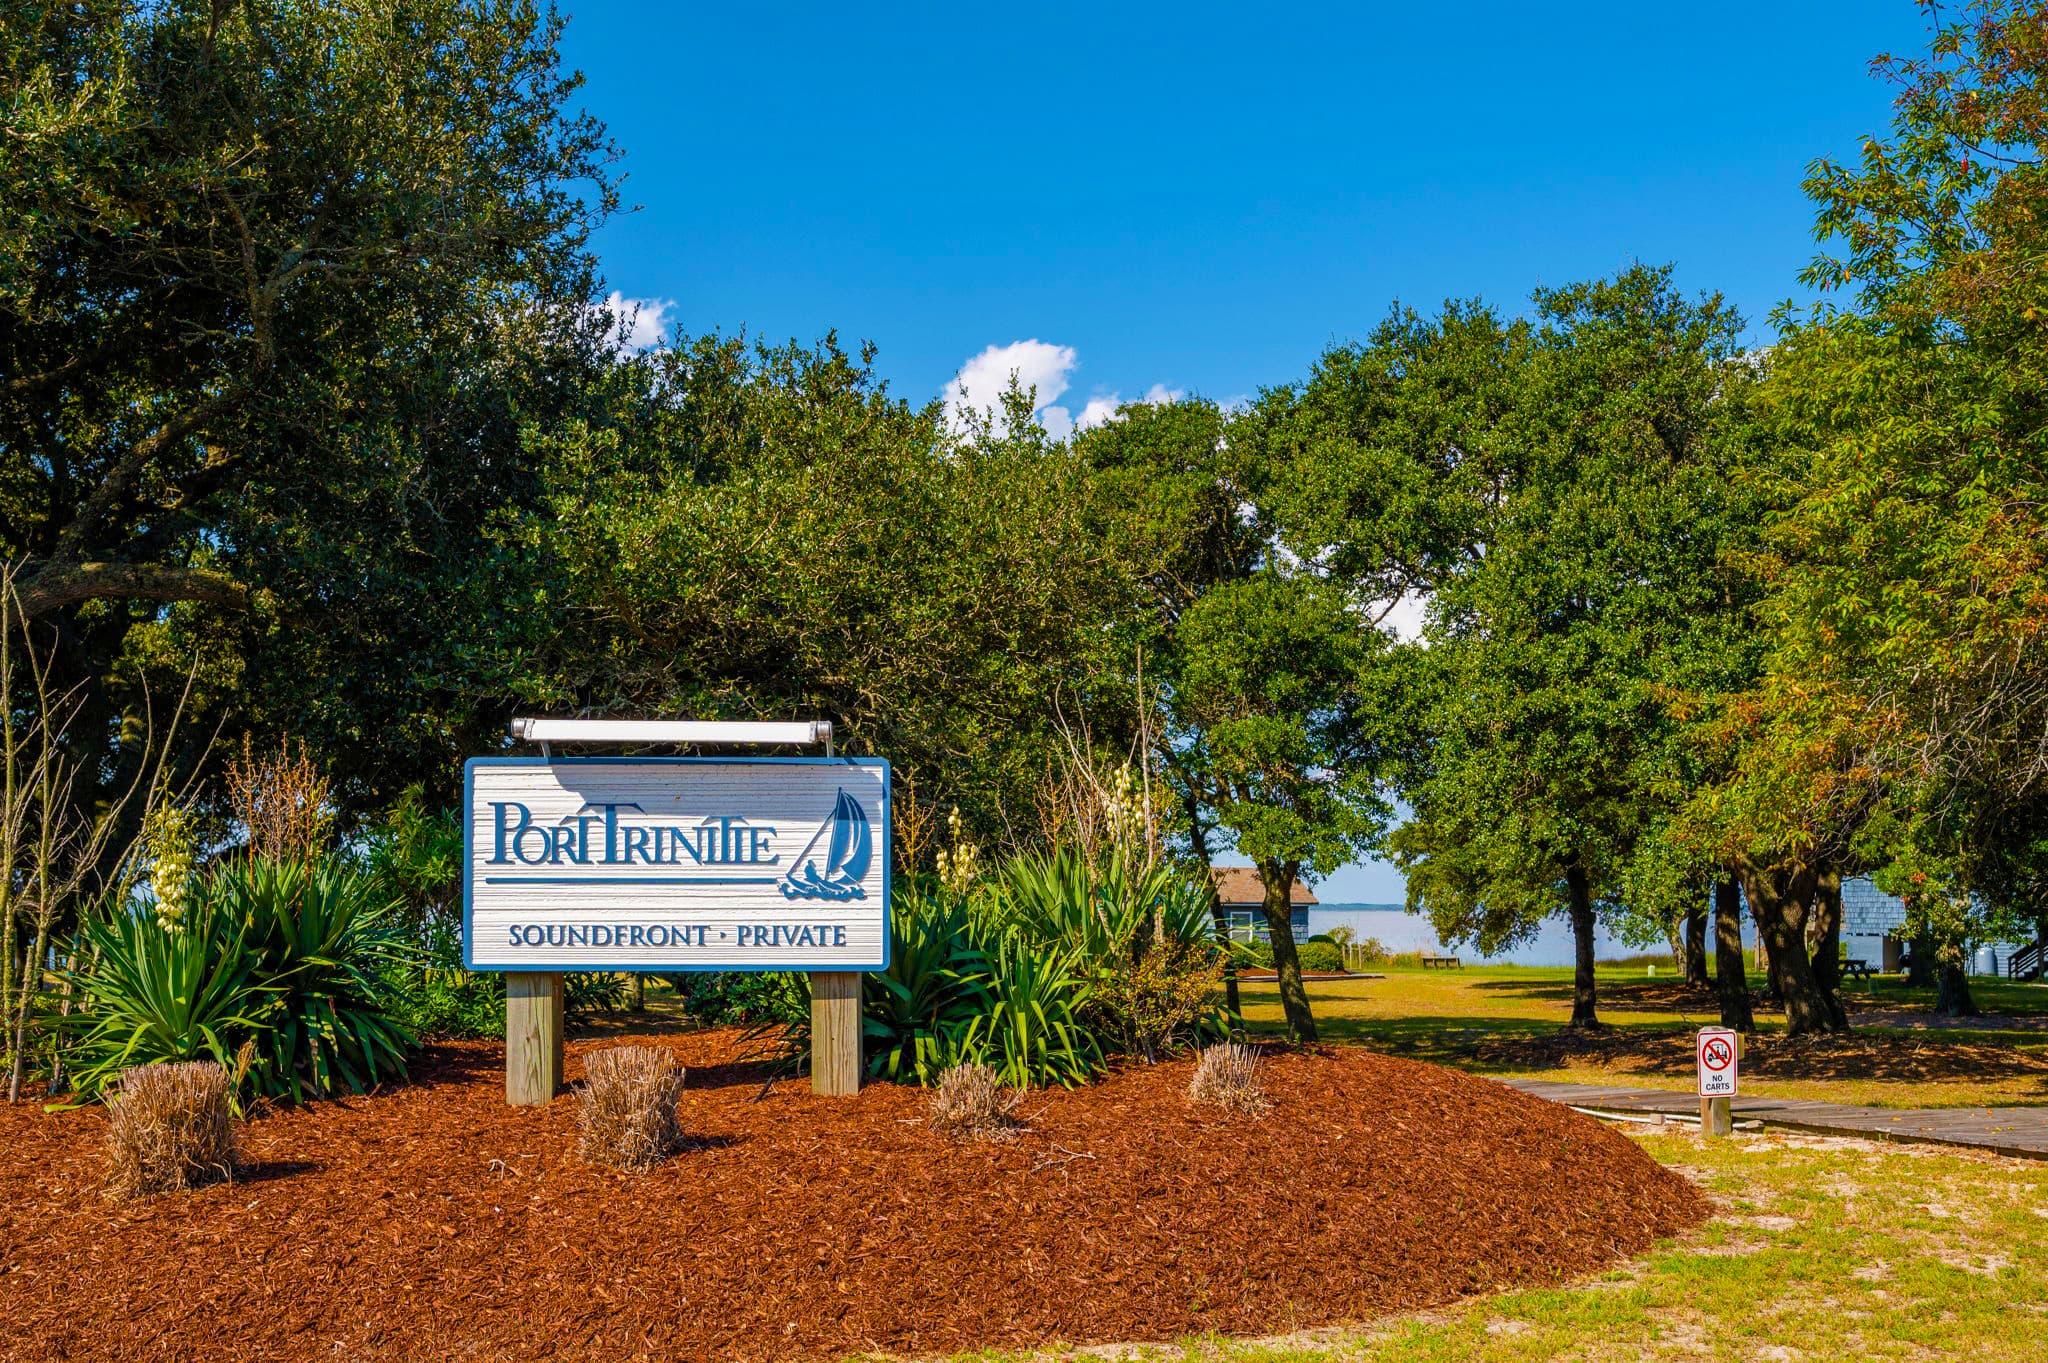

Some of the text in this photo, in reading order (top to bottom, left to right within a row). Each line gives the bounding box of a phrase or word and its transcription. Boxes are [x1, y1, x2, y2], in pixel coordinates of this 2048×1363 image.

[508, 924, 847, 947] SOUNDFRONT PRIVATE
[1712, 1074, 1723, 1082] NO
[1705, 1082, 1730, 1091] CARTS
